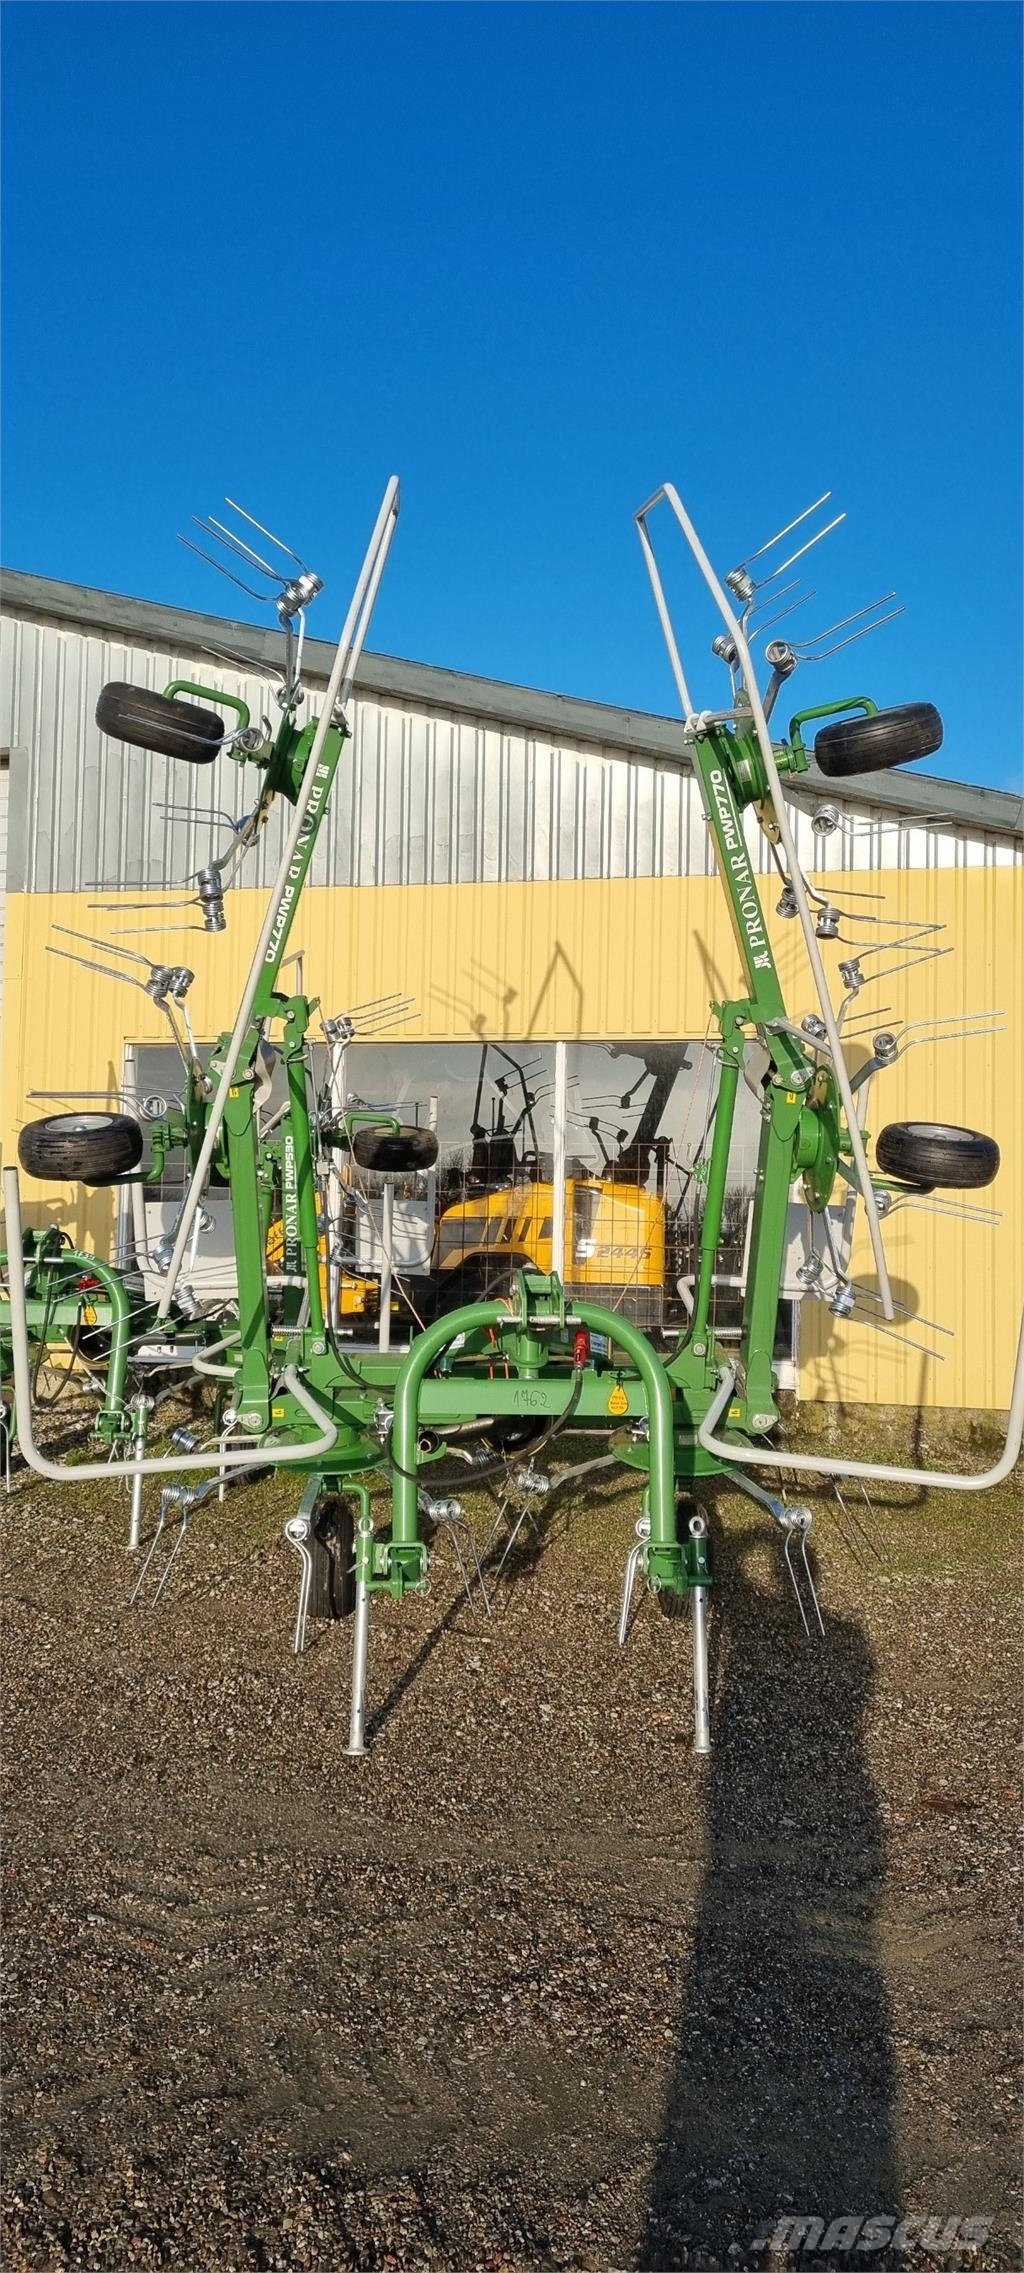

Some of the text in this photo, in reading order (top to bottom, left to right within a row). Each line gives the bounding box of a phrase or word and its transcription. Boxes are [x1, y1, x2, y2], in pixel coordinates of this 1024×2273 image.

[264, 786, 324, 964] PRONAR PWP770
[710, 769, 767, 950] PRONAR PWP770
[284, 1135, 298, 1257] PRONAR PWP530
[513, 1389, 552, 1409] 1762
